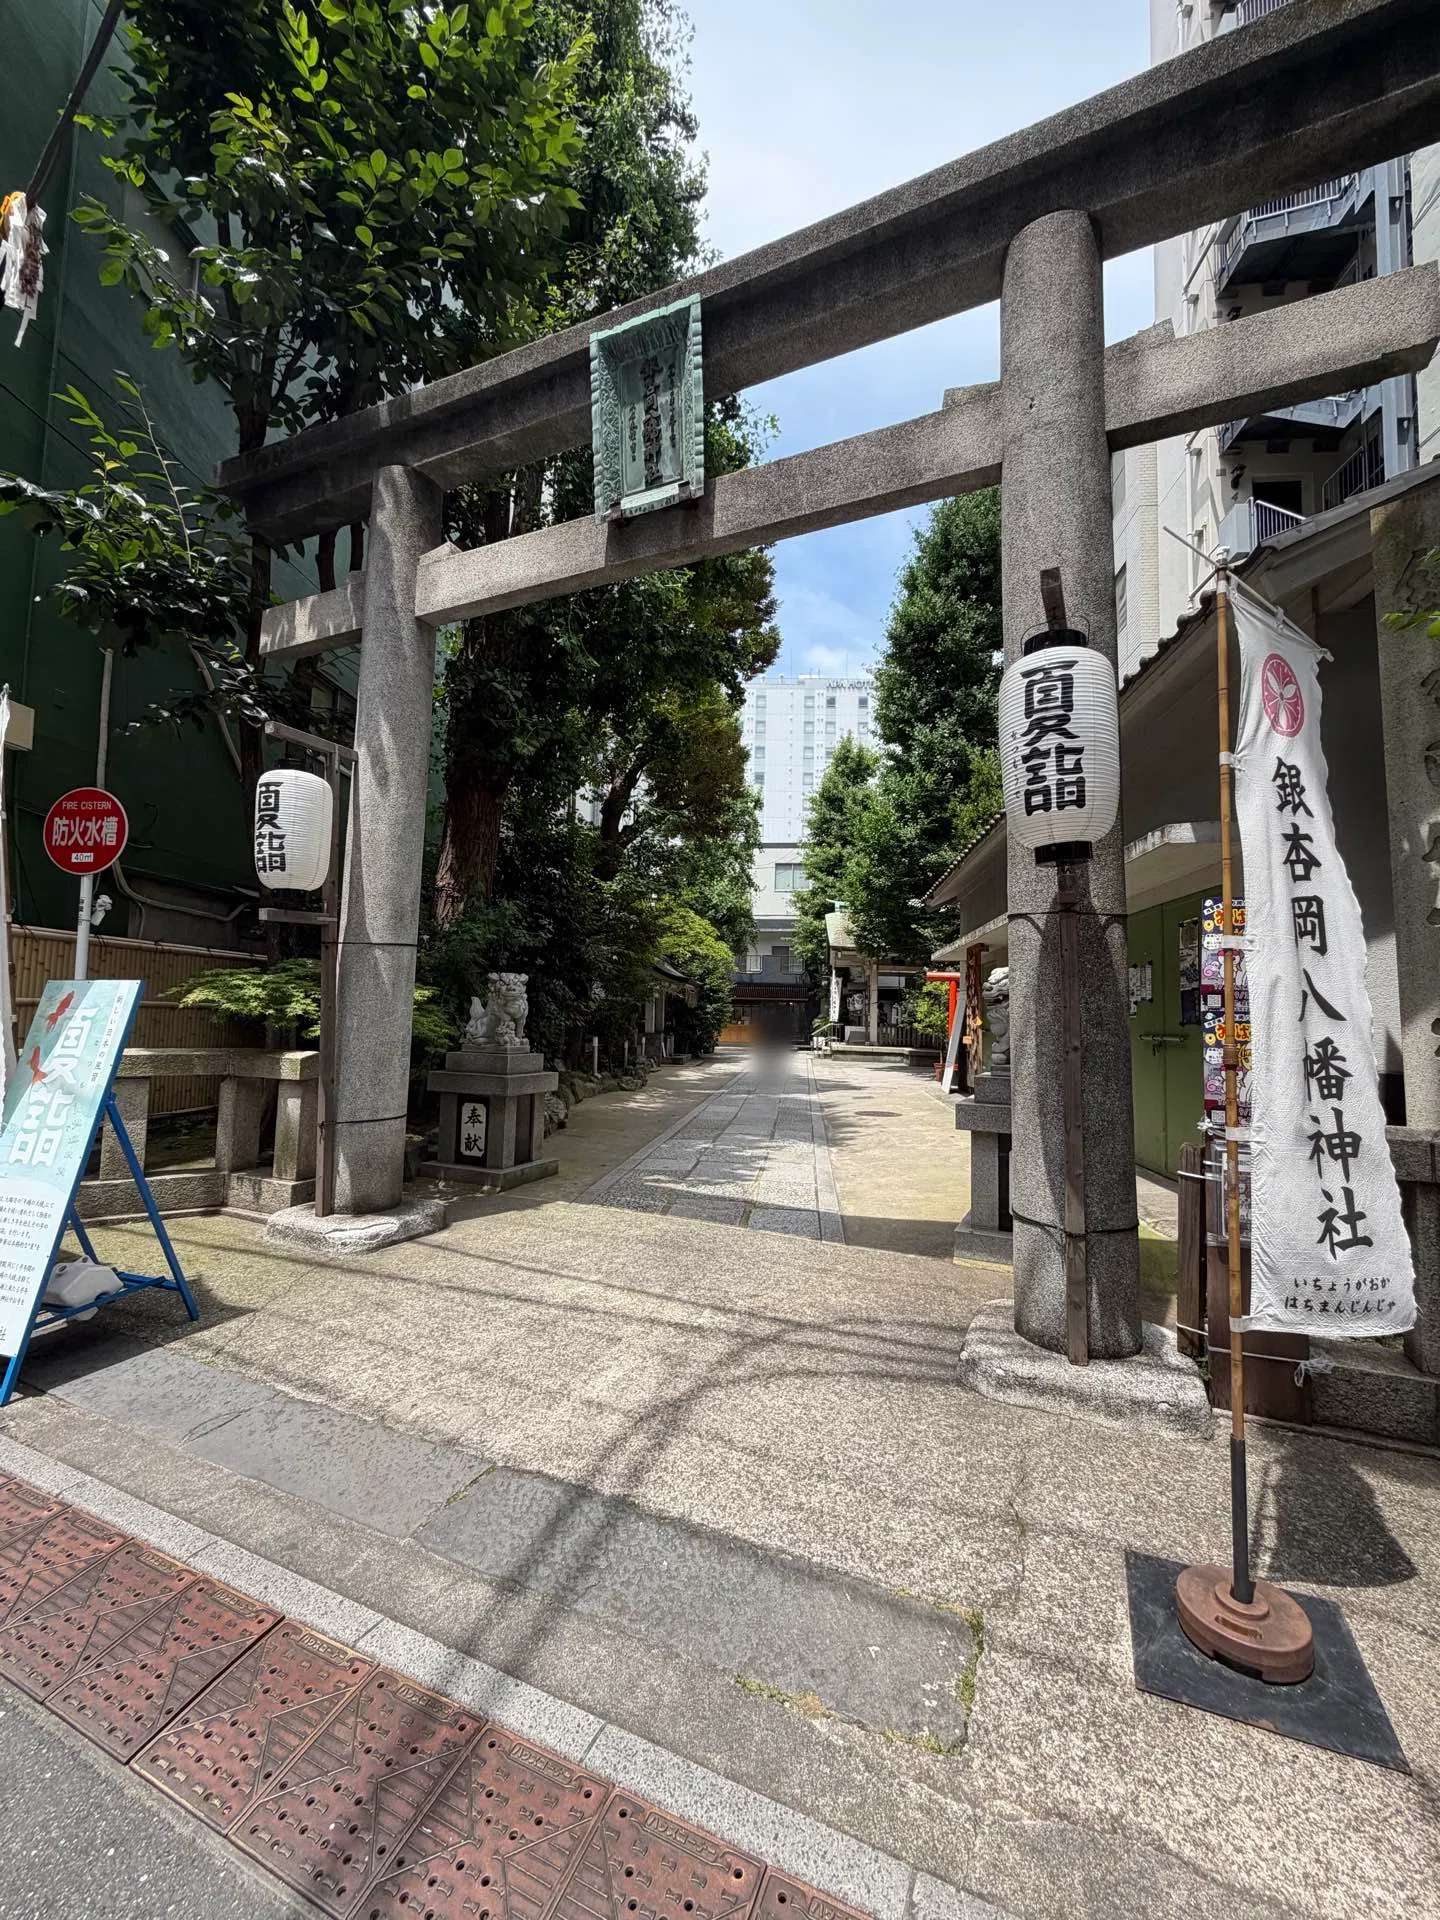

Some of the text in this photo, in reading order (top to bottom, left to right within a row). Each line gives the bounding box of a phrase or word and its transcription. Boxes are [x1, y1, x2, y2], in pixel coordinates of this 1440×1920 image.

[1020, 660, 1086, 816] 夏詣
[62, 801, 112, 810] FIRE CISTERN
[256, 781, 287, 873] 夏詣
[52, 816, 119, 846] 防火水槽
[1272, 755, 1374, 1260] 銀杏岡八幡神社
[8, 1008, 100, 1167] 夏詣
[463, 1105, 484, 1153] 奉献
[1284, 1295, 1397, 1313] はちまんじんじゃ
[1294, 1277, 1391, 1293] いちょうがおか
